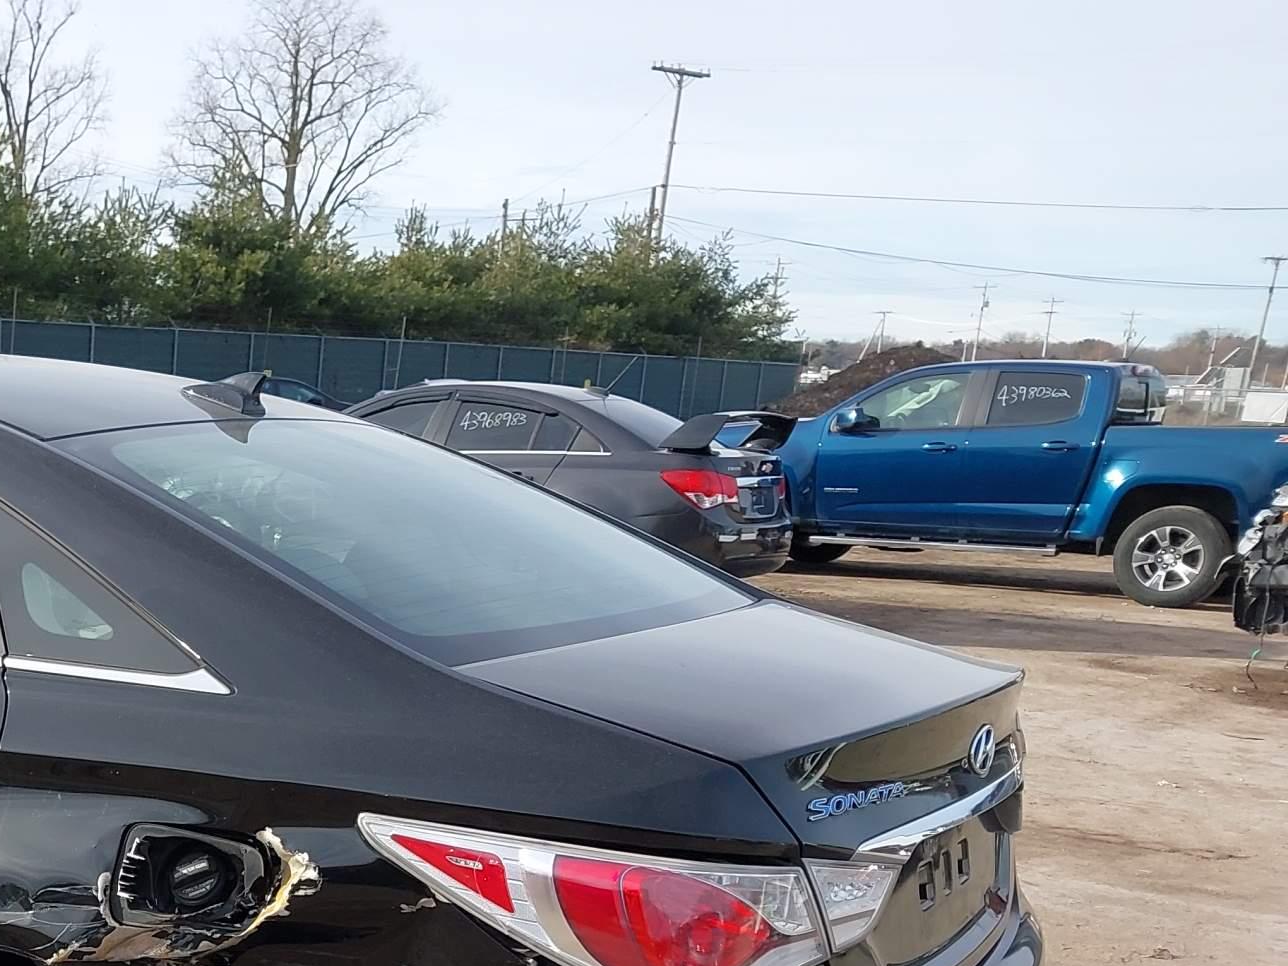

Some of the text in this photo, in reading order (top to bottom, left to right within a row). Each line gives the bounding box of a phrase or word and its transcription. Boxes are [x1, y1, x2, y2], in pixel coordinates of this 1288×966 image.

[997, 385, 1071, 406] 43980362
[460, 411, 527, 430] 43968983
[808, 782, 905, 821] SONATA
